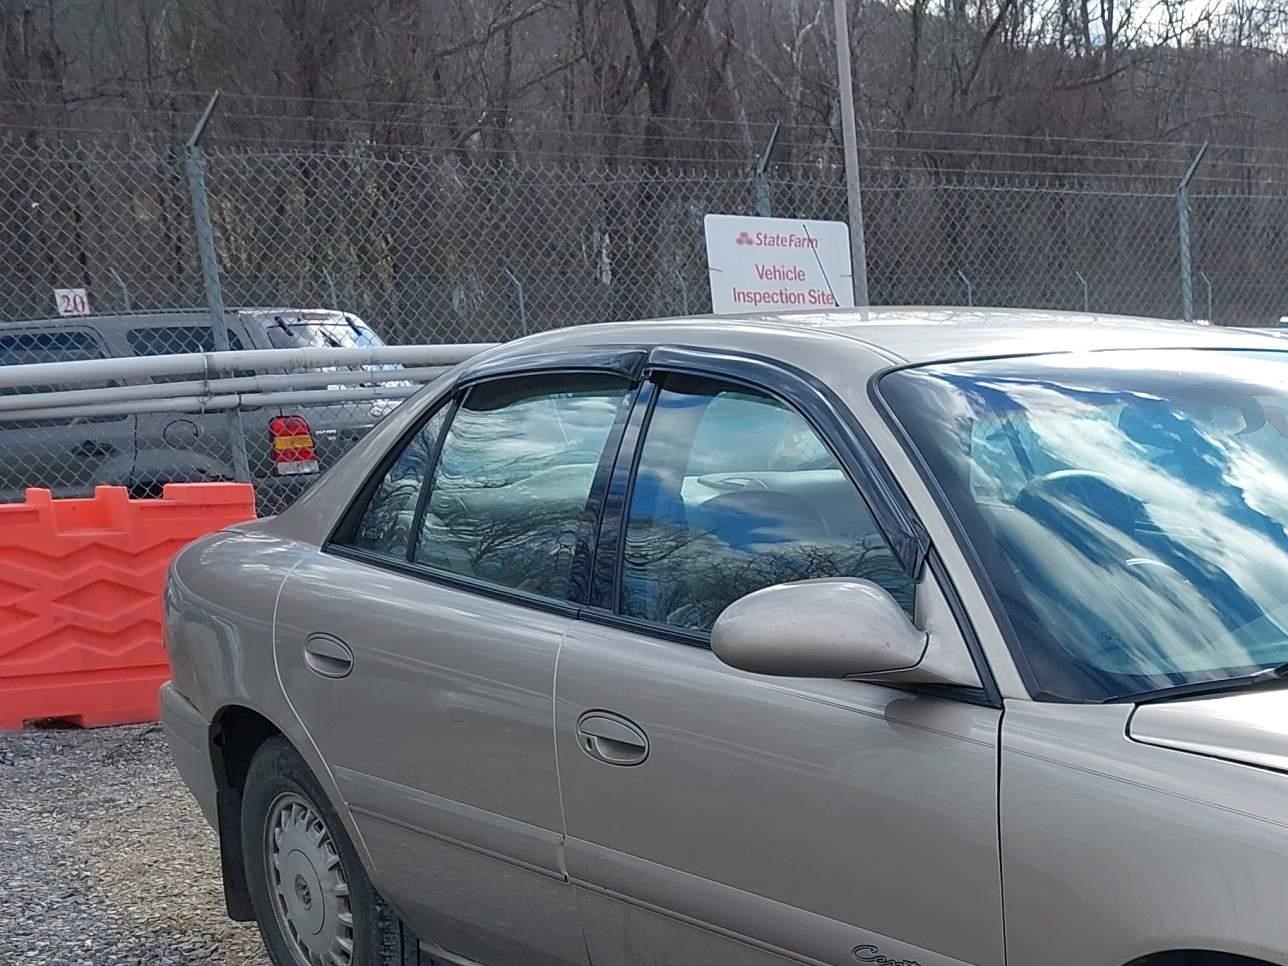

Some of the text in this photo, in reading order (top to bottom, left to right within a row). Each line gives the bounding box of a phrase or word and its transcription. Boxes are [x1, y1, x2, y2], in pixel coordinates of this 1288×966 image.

[755, 264, 806, 282] Vehicle
[61, 295, 85, 313] 20
[733, 287, 834, 306] Inspection Site
